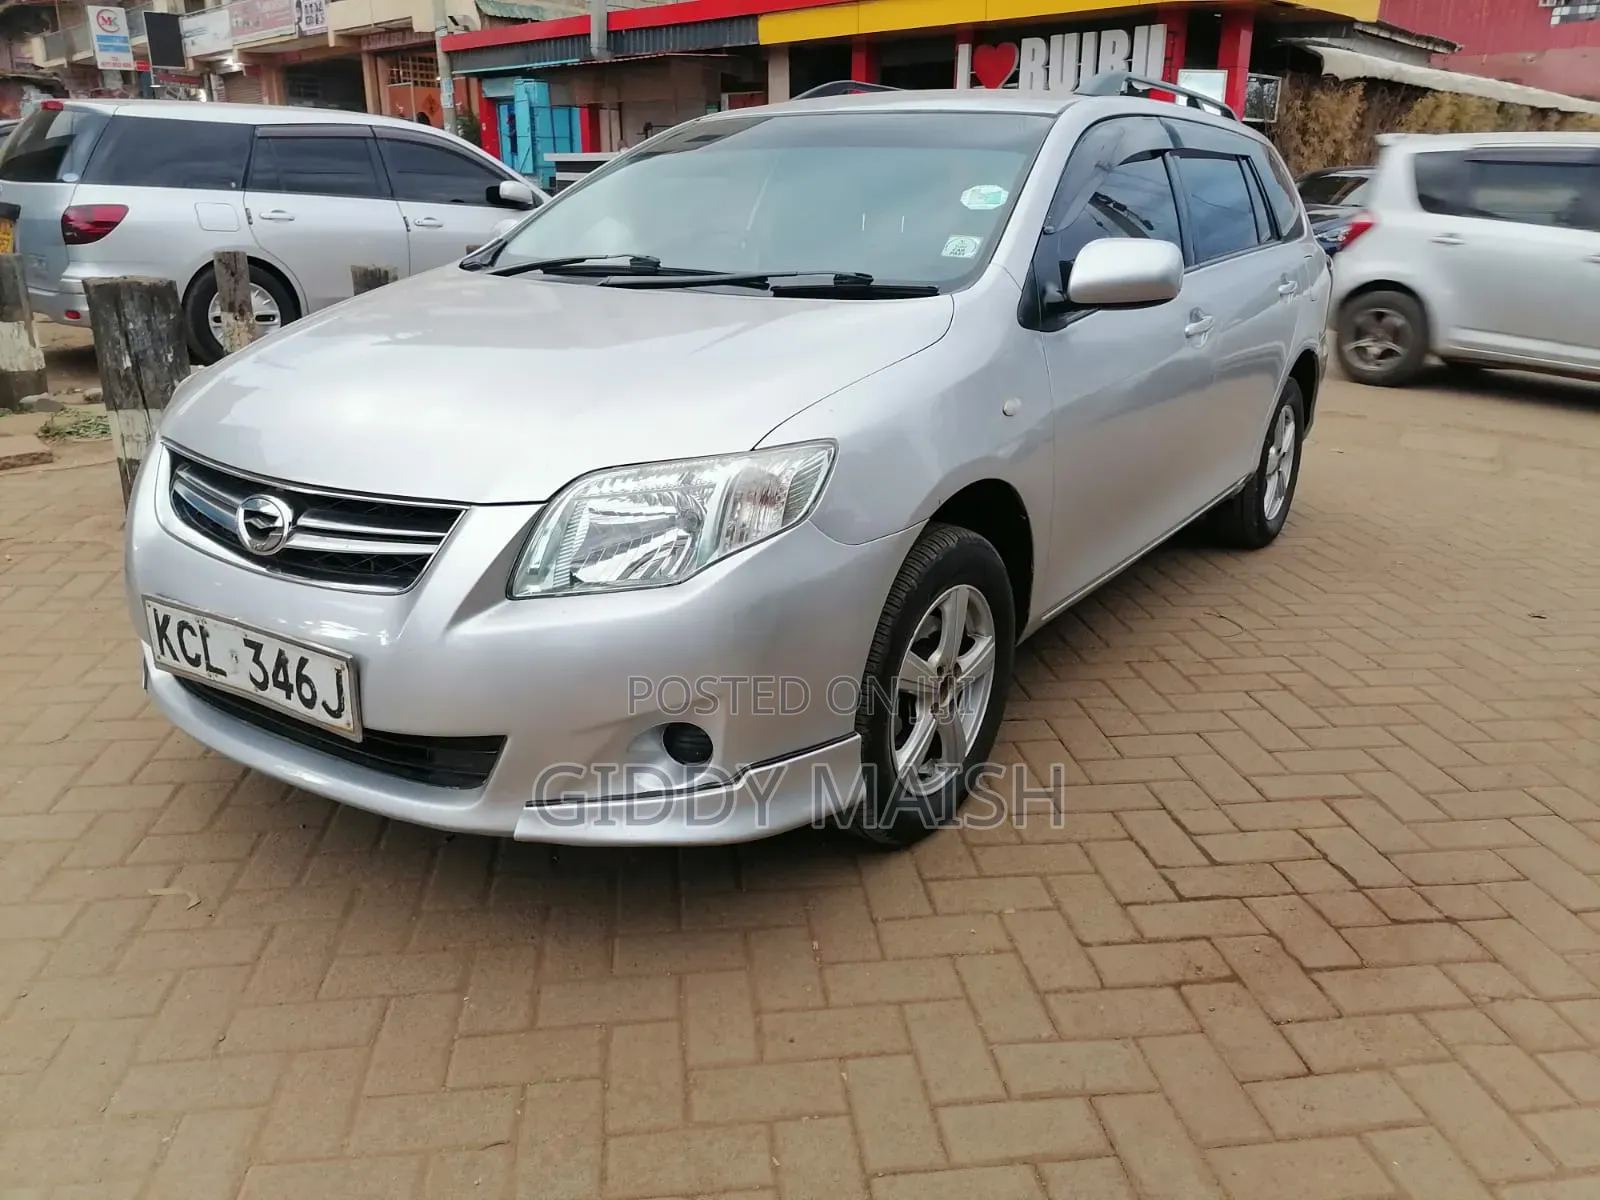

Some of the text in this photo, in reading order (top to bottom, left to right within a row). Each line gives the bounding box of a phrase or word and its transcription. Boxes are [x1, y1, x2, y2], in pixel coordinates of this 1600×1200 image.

[956, 23, 1168, 92] I RUIRU
[153, 607, 345, 719] KCL 346J
